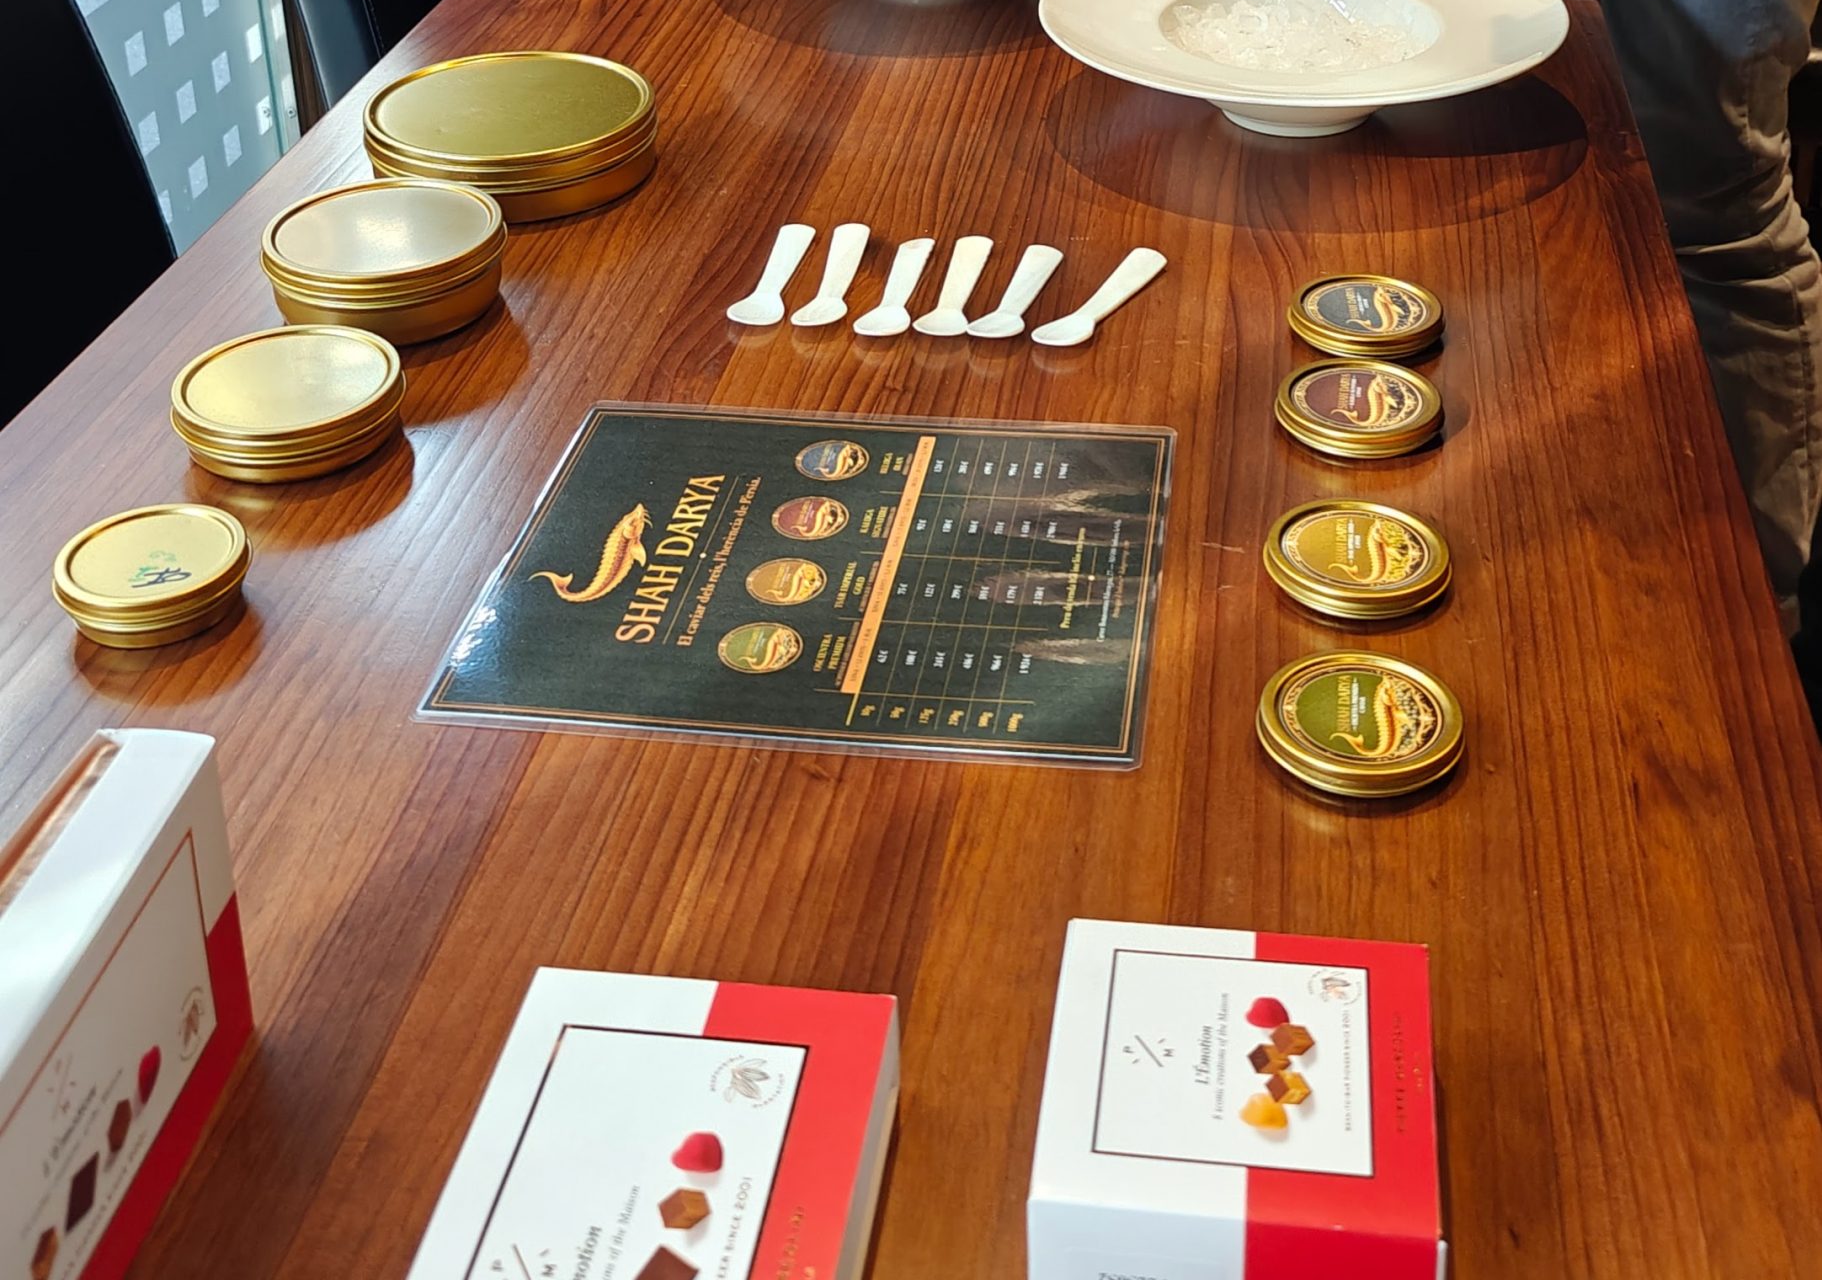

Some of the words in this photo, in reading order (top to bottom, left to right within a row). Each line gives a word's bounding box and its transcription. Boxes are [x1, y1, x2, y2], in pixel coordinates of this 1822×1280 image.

[739, 476, 762, 504] Persia.
[734, 503, 747, 517] de
[615, 564, 684, 643] SHAH
[655, 475, 726, 557] DARYA
[709, 562, 727, 583] reis,
[697, 583, 715, 604] dels
[687, 604, 706, 636] caviar
[677, 634, 694, 646] El
[1337, 675, 1352, 705] DARYA
[1123, 1045, 1134, 1054] P
[1163, 1048, 1175, 1057] M
[735, 1176, 752, 1210] 2001
[618, 1185, 640, 1225] Maison
[542, 1263, 556, 1277] M
